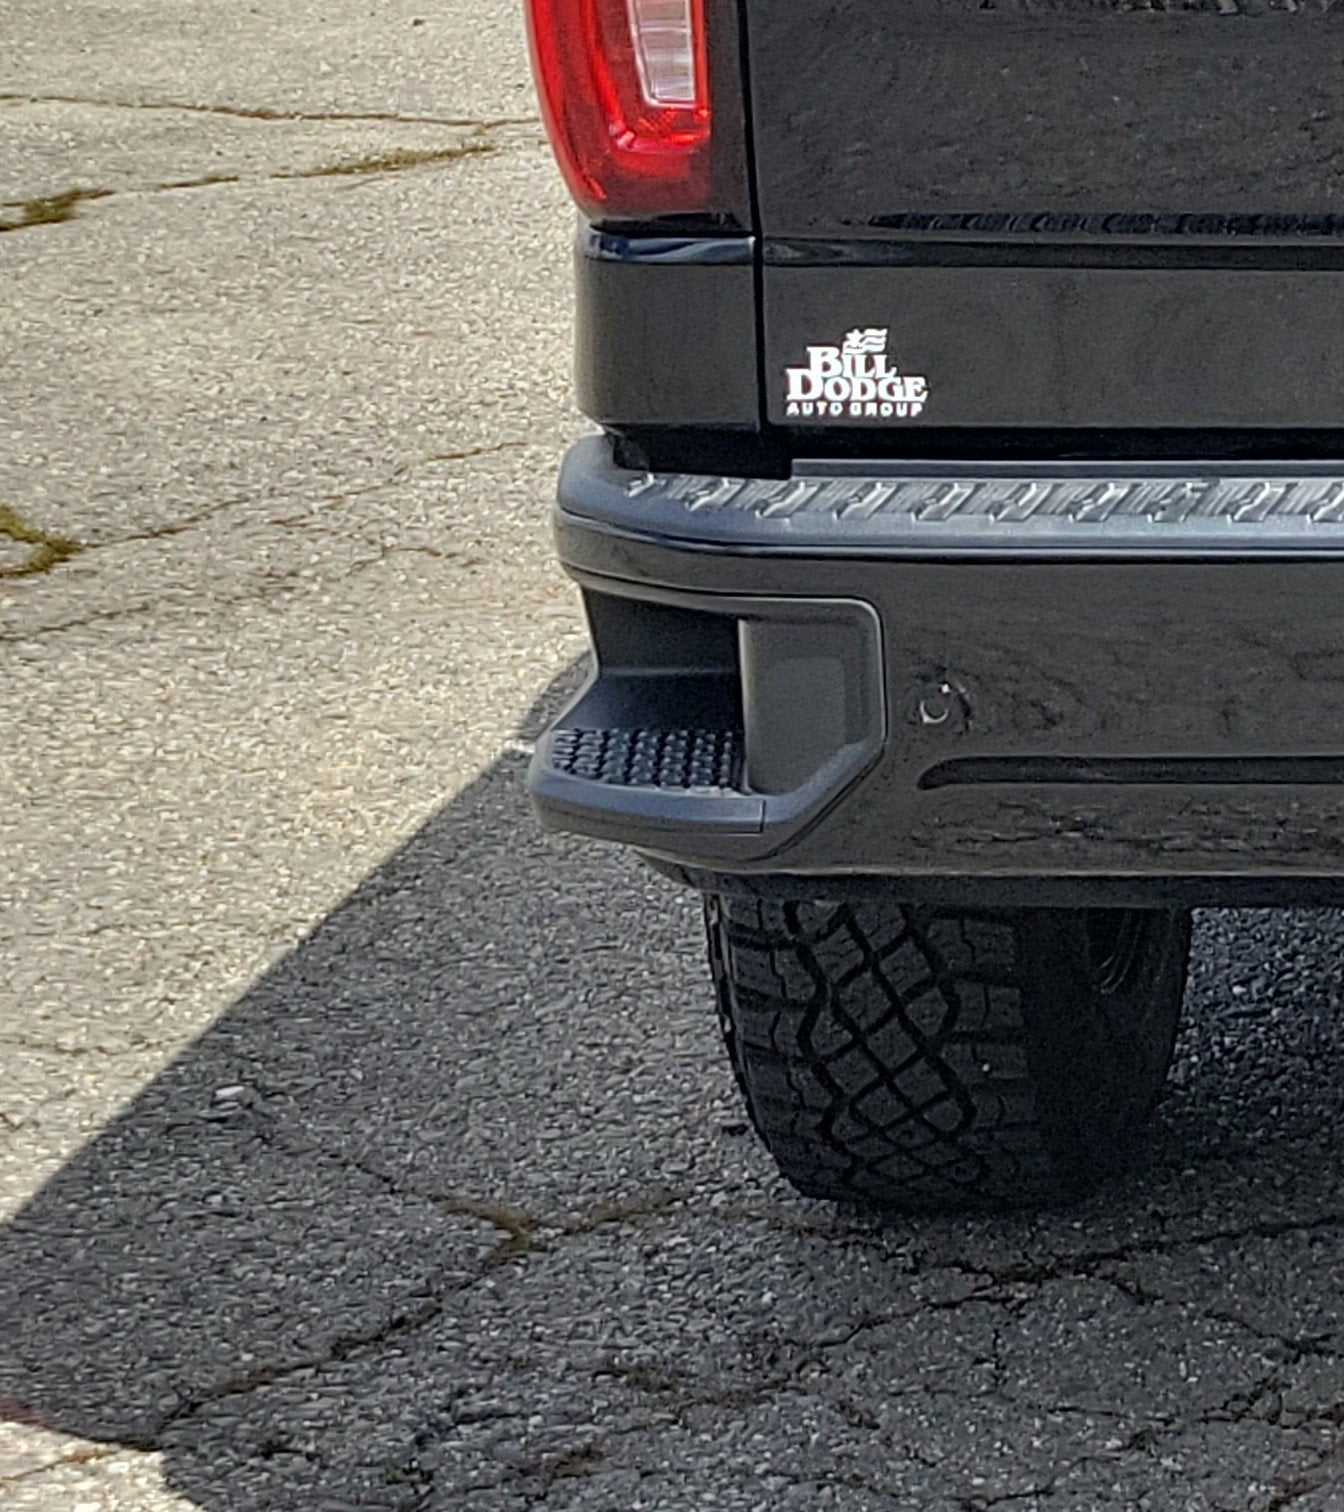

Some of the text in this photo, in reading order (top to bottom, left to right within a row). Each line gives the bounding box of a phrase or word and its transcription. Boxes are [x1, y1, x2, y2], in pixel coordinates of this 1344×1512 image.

[806, 346, 897, 378] BILL
[785, 368, 929, 403] DODGE
[786, 402, 924, 417] AUTO GROUP
